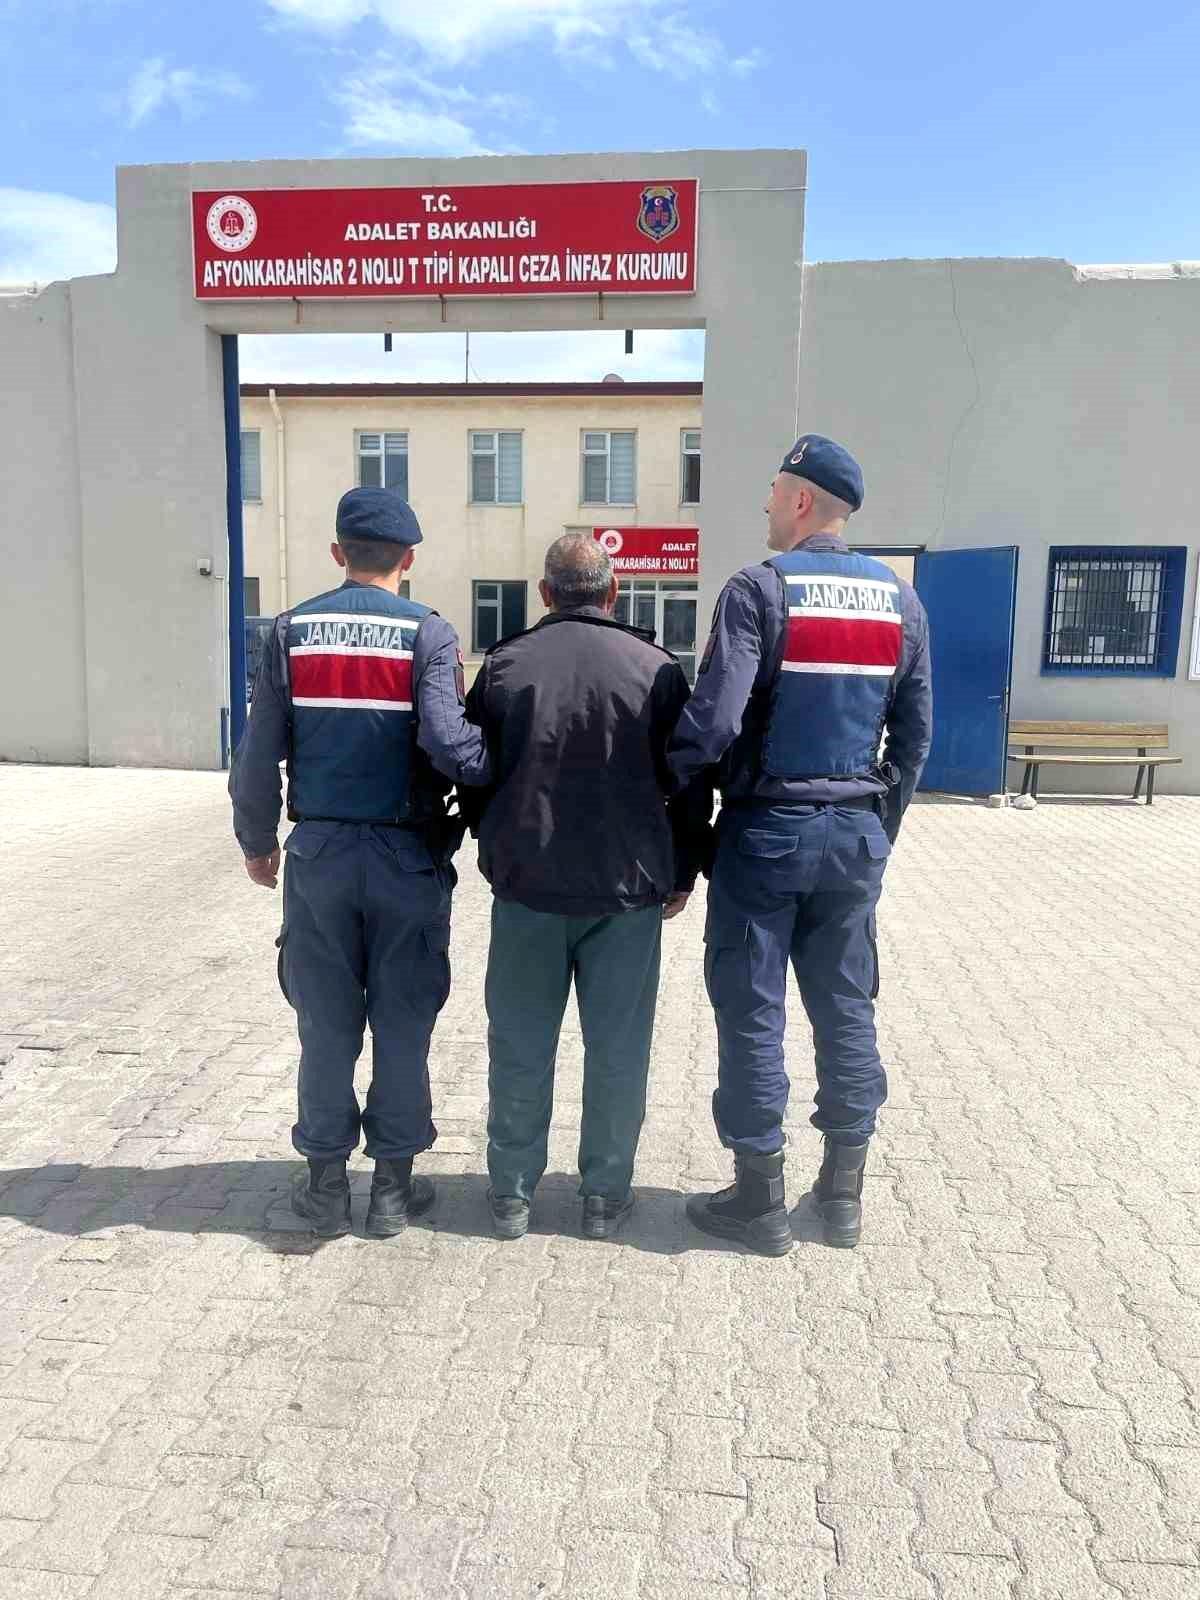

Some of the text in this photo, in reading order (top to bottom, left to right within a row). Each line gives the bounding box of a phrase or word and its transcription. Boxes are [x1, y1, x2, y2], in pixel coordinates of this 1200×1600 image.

[422, 194, 457, 212] T.C.
[345, 217, 536, 241] ADALET BAKANLIĞI
[203, 248, 688, 287] AFYONKARAHİSAR 2 NOLU T TİPİ KAPALI CEZA İNFAZ KURUMU
[662, 542, 696, 551] ADALET
[609, 555, 661, 570] ONKARAHİSAR
[662, 557, 667, 570] 2
[668, 557, 688, 570] NOLU
[690, 557, 695, 570] T
[800, 584, 895, 613] JANDARMA
[301, 622, 401, 649] JANDARMA
